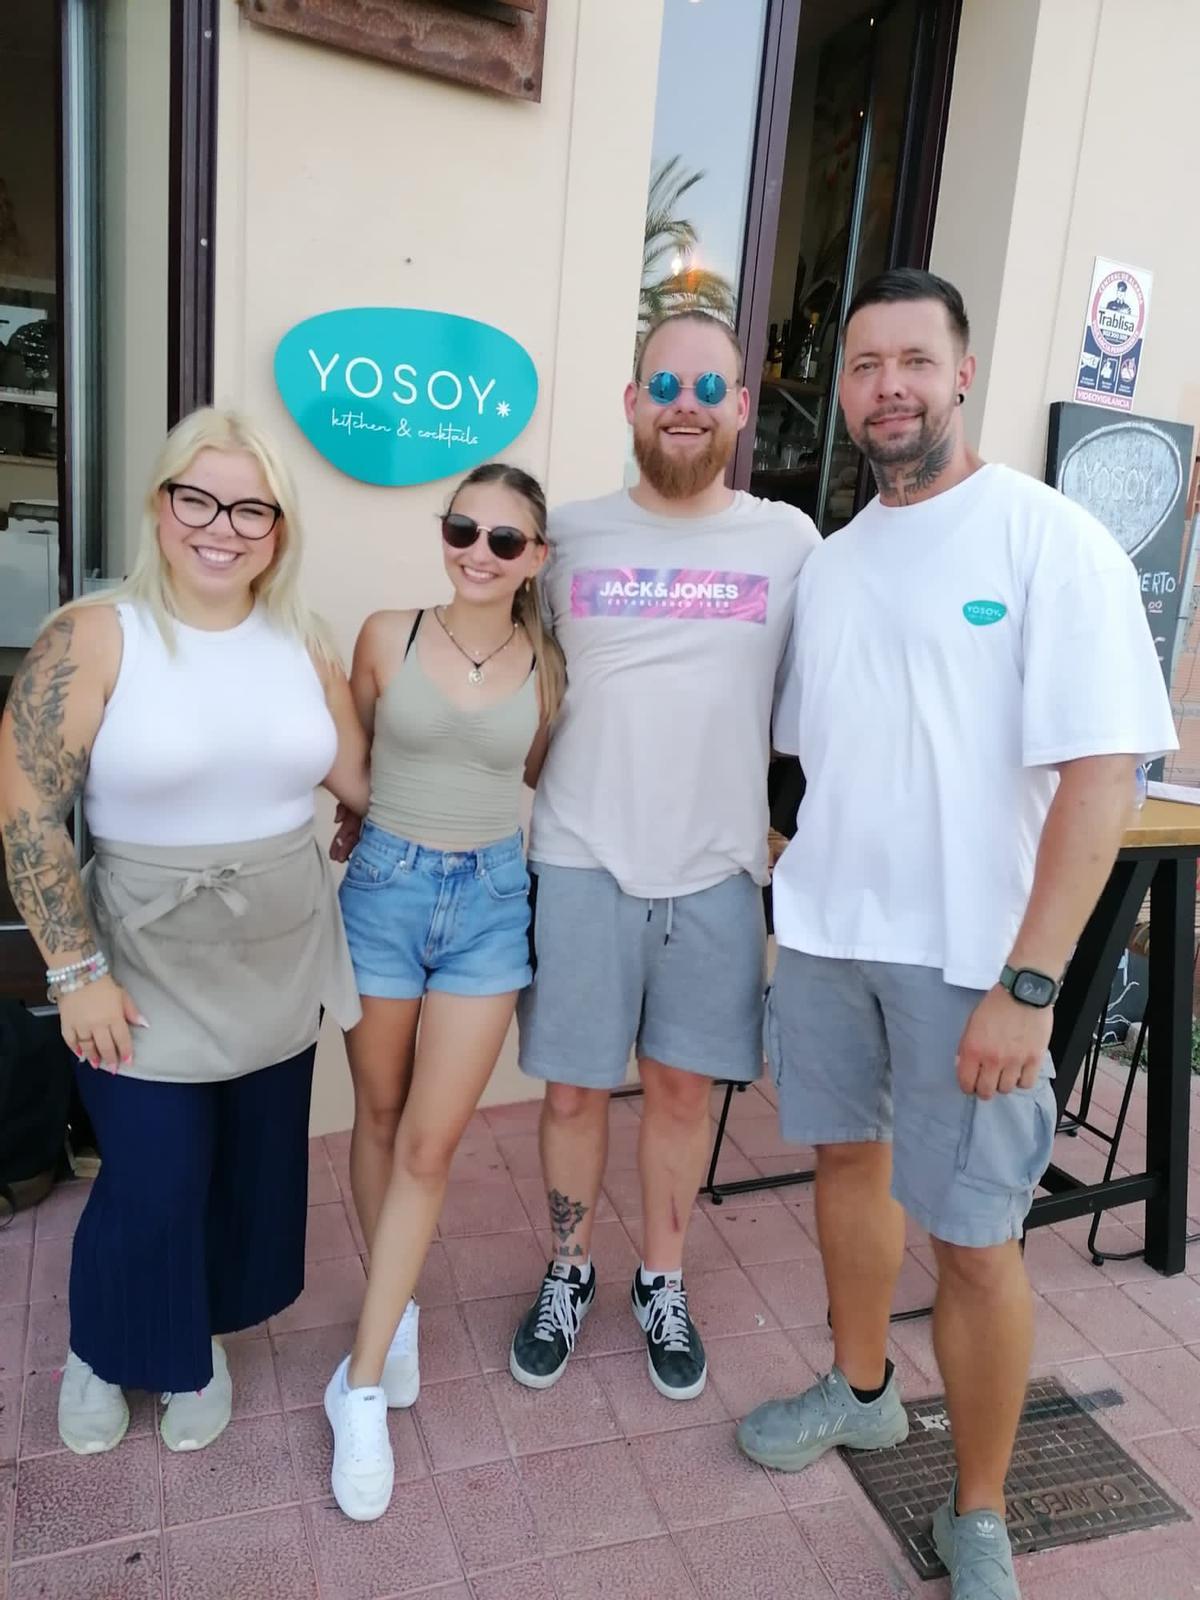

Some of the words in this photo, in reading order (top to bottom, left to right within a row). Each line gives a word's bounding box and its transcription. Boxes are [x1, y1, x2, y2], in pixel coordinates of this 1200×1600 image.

[1099, 310, 1135, 333] Trablisa
[308, 349, 496, 415] YOSOY
[331, 408, 391, 436] kitchen
[396, 418, 412, 438] &
[417, 422, 479, 449] cocktails
